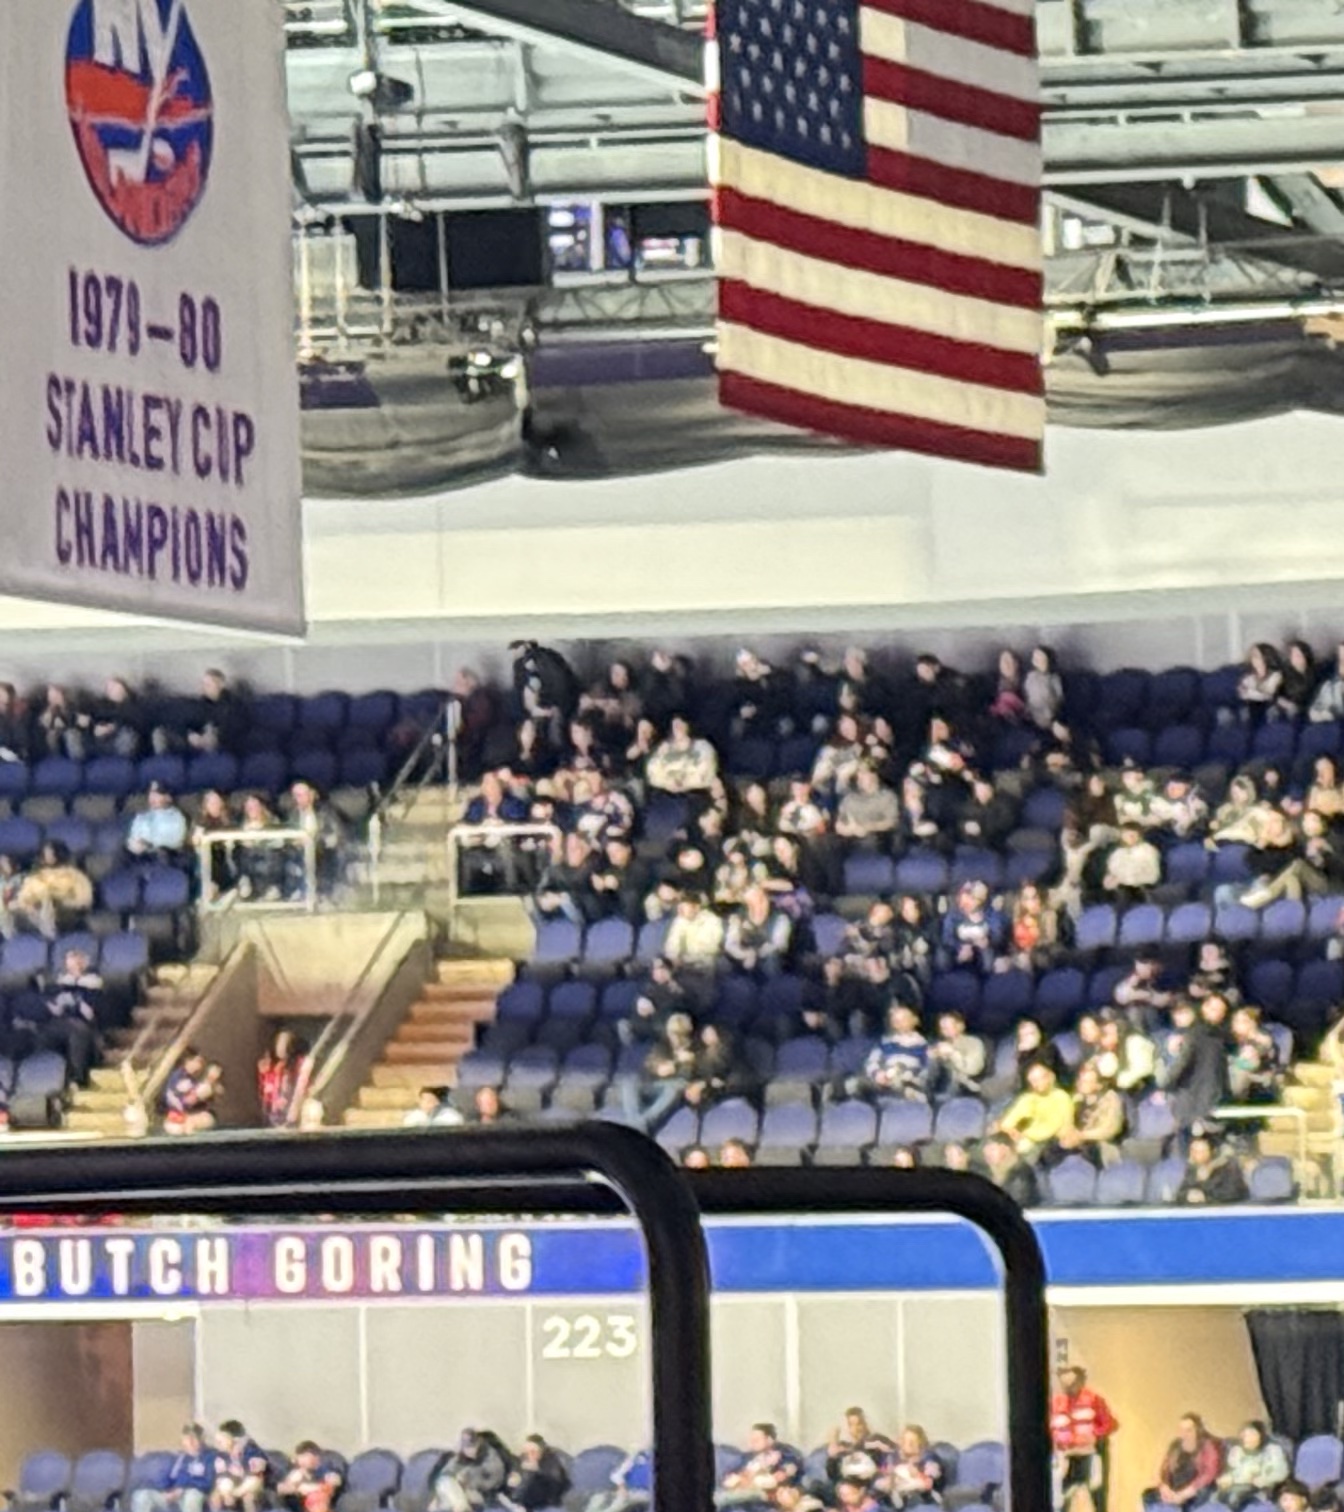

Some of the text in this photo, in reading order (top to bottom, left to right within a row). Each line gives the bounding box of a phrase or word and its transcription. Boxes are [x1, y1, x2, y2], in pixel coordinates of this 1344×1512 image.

[46, 371, 255, 487] STANLEY CUP
[55, 485, 249, 592] CHAMPIONS
[12, 1233, 533, 1297] BUTCH GORING
[542, 1315, 637, 1359] 223
